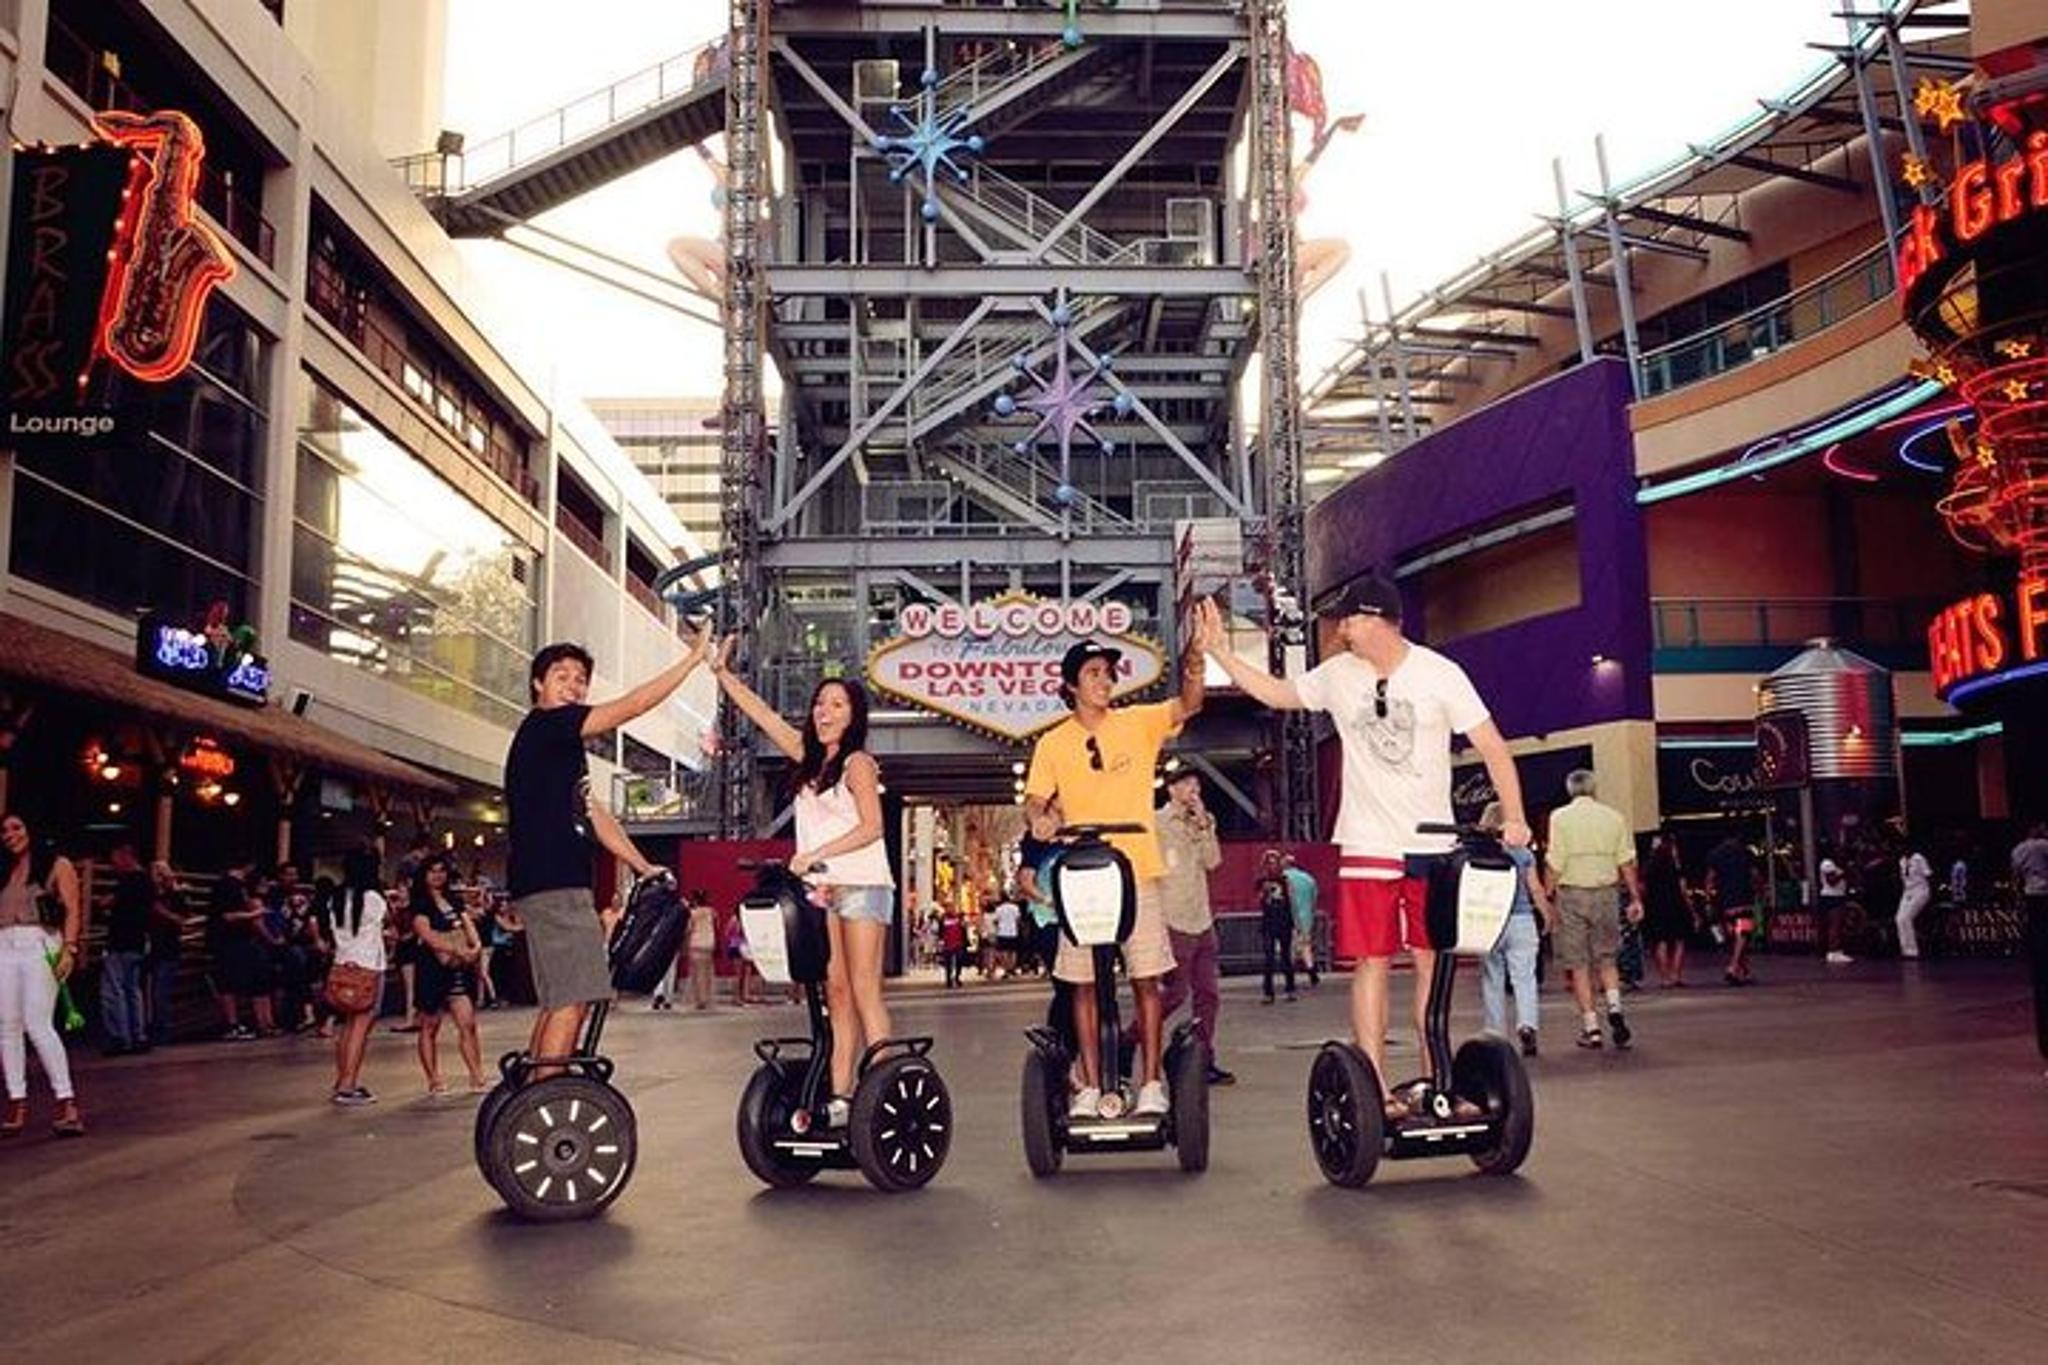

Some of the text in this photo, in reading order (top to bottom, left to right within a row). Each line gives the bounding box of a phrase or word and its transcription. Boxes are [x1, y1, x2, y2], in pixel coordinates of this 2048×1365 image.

[11, 164, 70, 400] BRASS
[9, 411, 116, 436] Lounge
[902, 604, 1127, 633] WELCOME
[957, 634, 1068, 660] Fabulou
[899, 659, 1133, 680] DOWNTON
[926, 680, 986, 697] LAS
